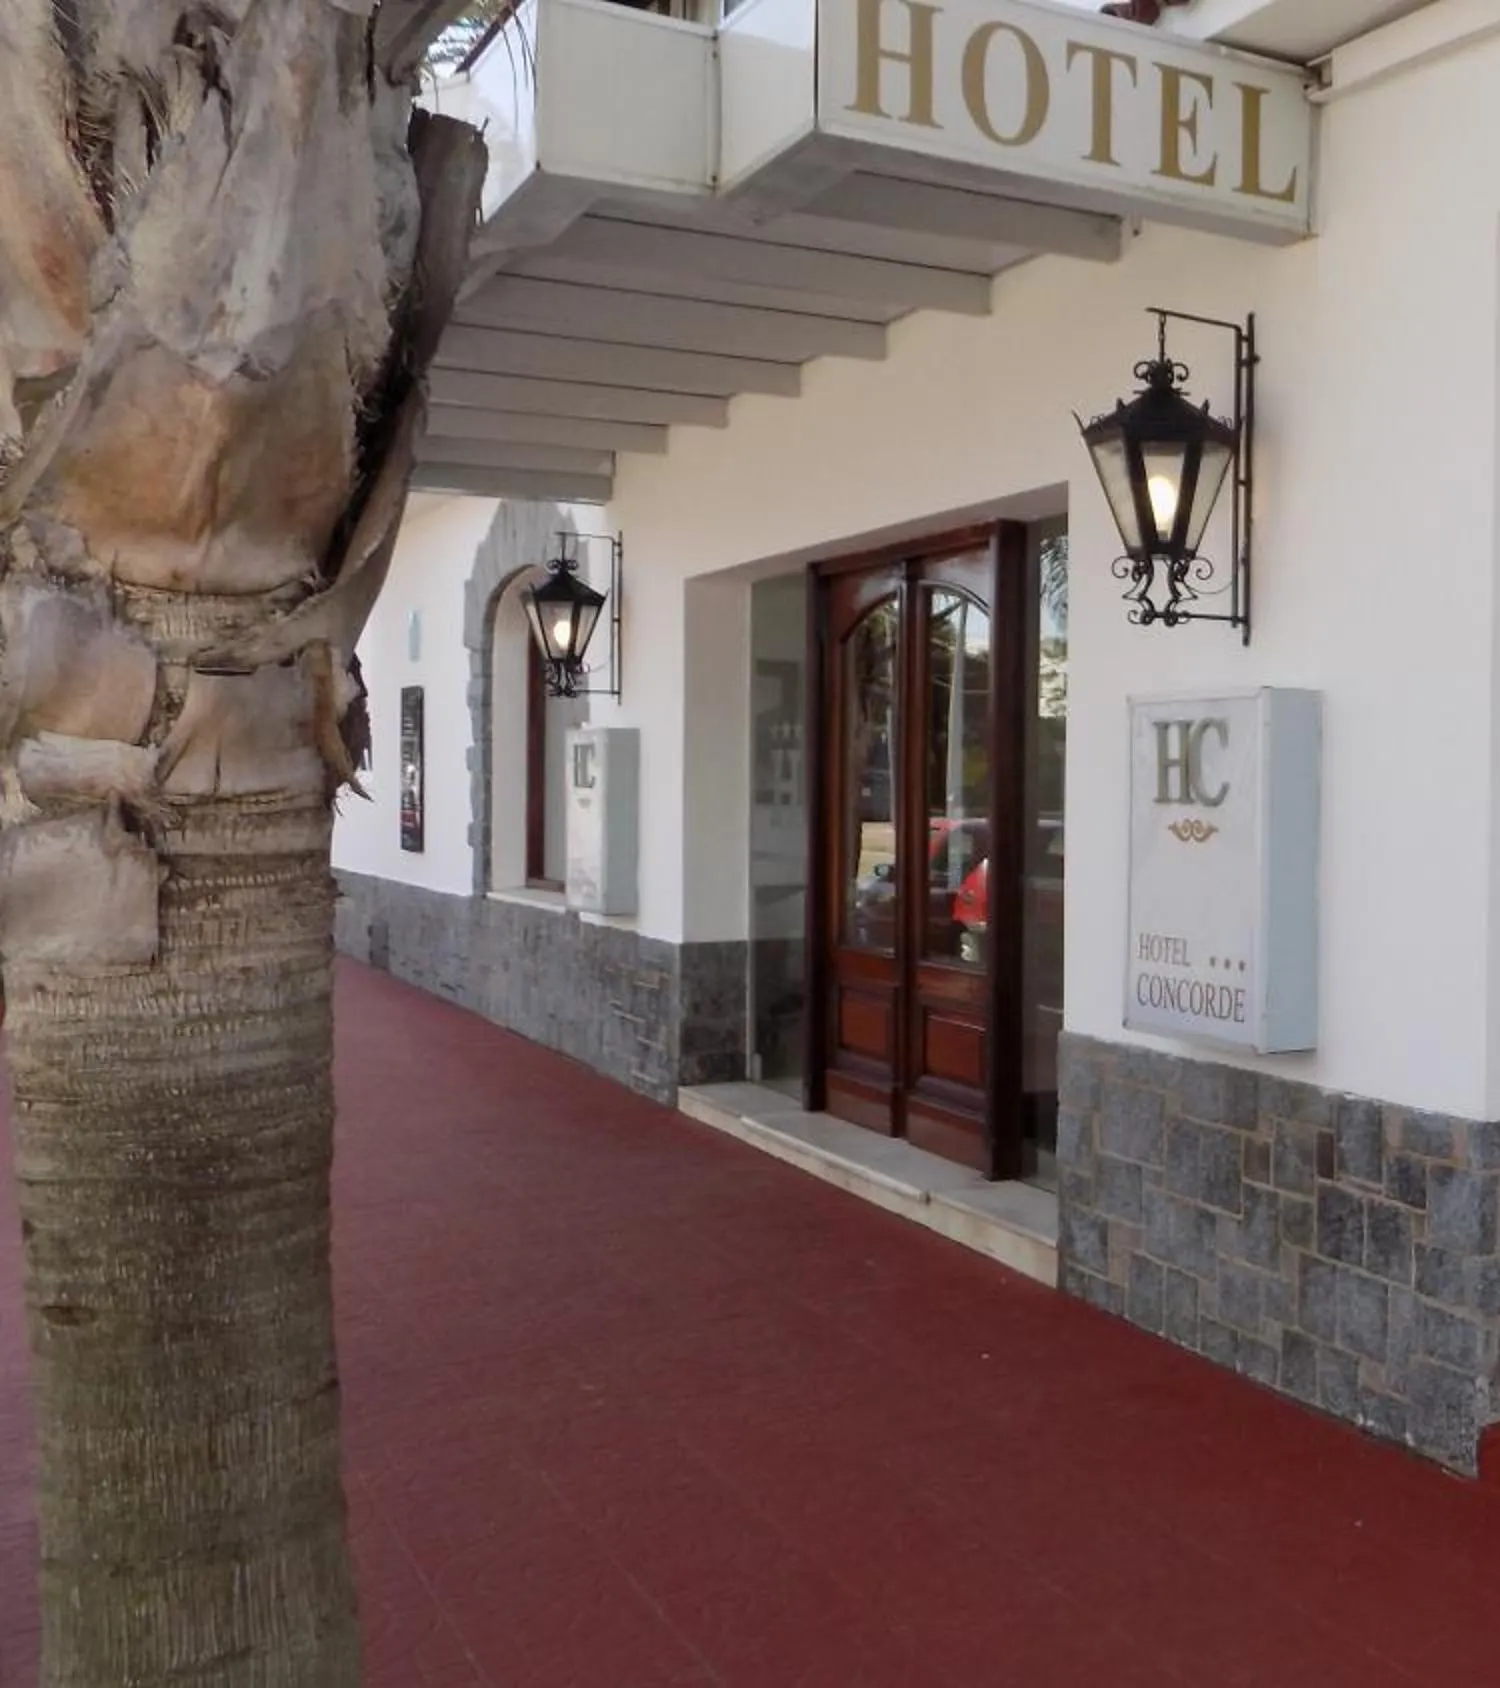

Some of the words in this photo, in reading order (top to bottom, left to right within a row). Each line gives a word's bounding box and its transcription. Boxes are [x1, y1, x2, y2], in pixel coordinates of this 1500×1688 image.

[844, 0, 1298, 203] HOTEL
[1152, 717, 1230, 808] HC
[1138, 932, 1191, 967] HOTEL
[1136, 972, 1246, 1023] CONCORDE
